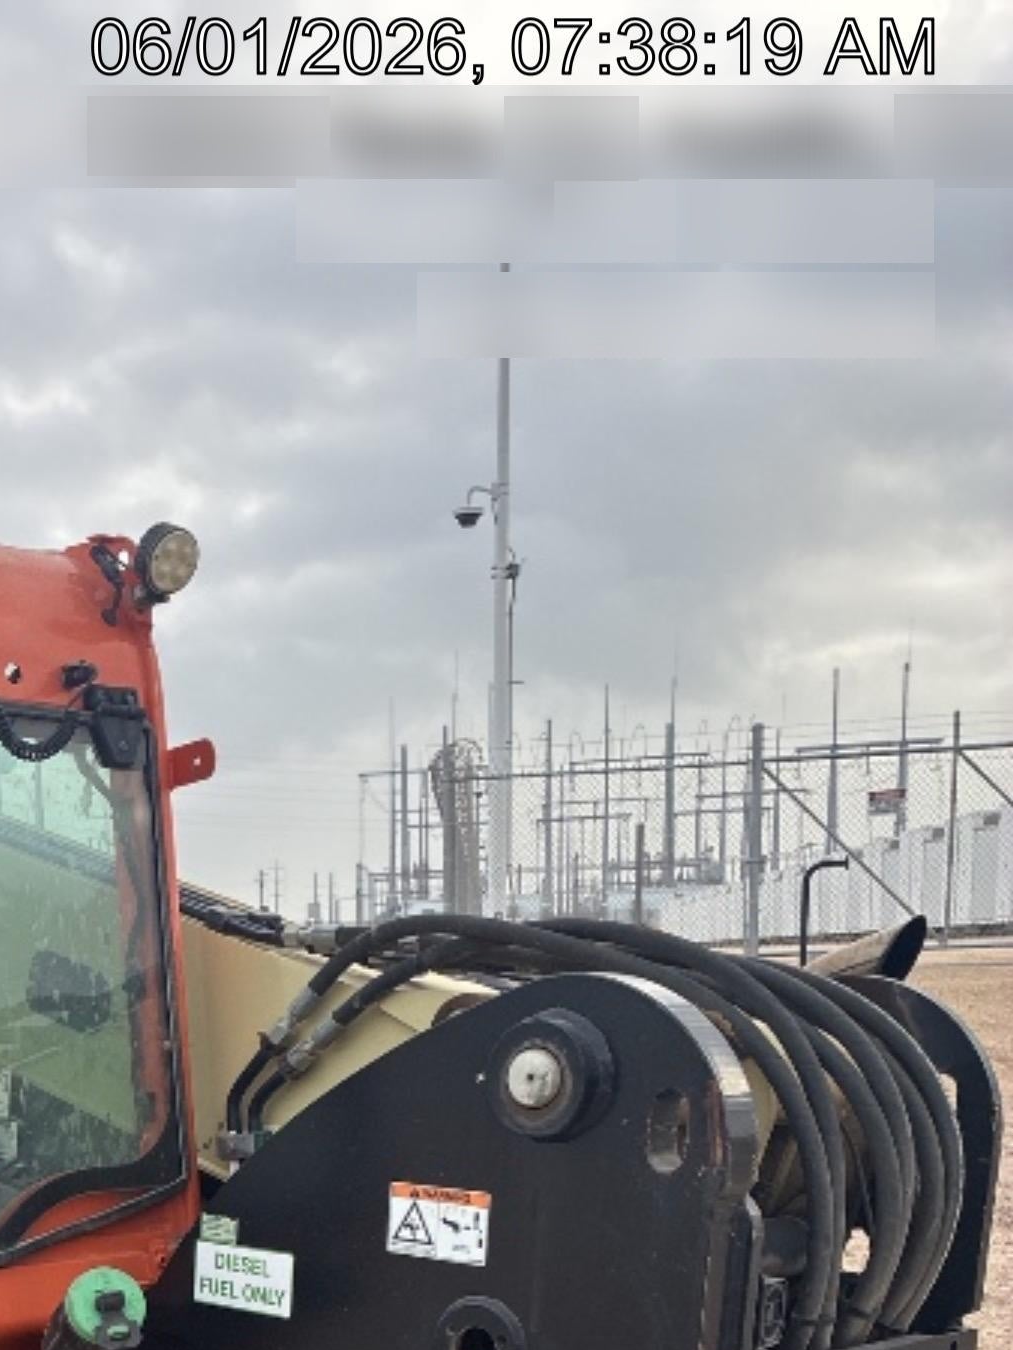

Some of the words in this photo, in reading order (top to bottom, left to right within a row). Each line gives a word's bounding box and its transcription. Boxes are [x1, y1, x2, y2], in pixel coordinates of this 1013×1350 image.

[214, 1252, 270, 1279] DIESEL
[199, 1276, 239, 1300] FUEL
[242, 1283, 286, 1308] ONLY
